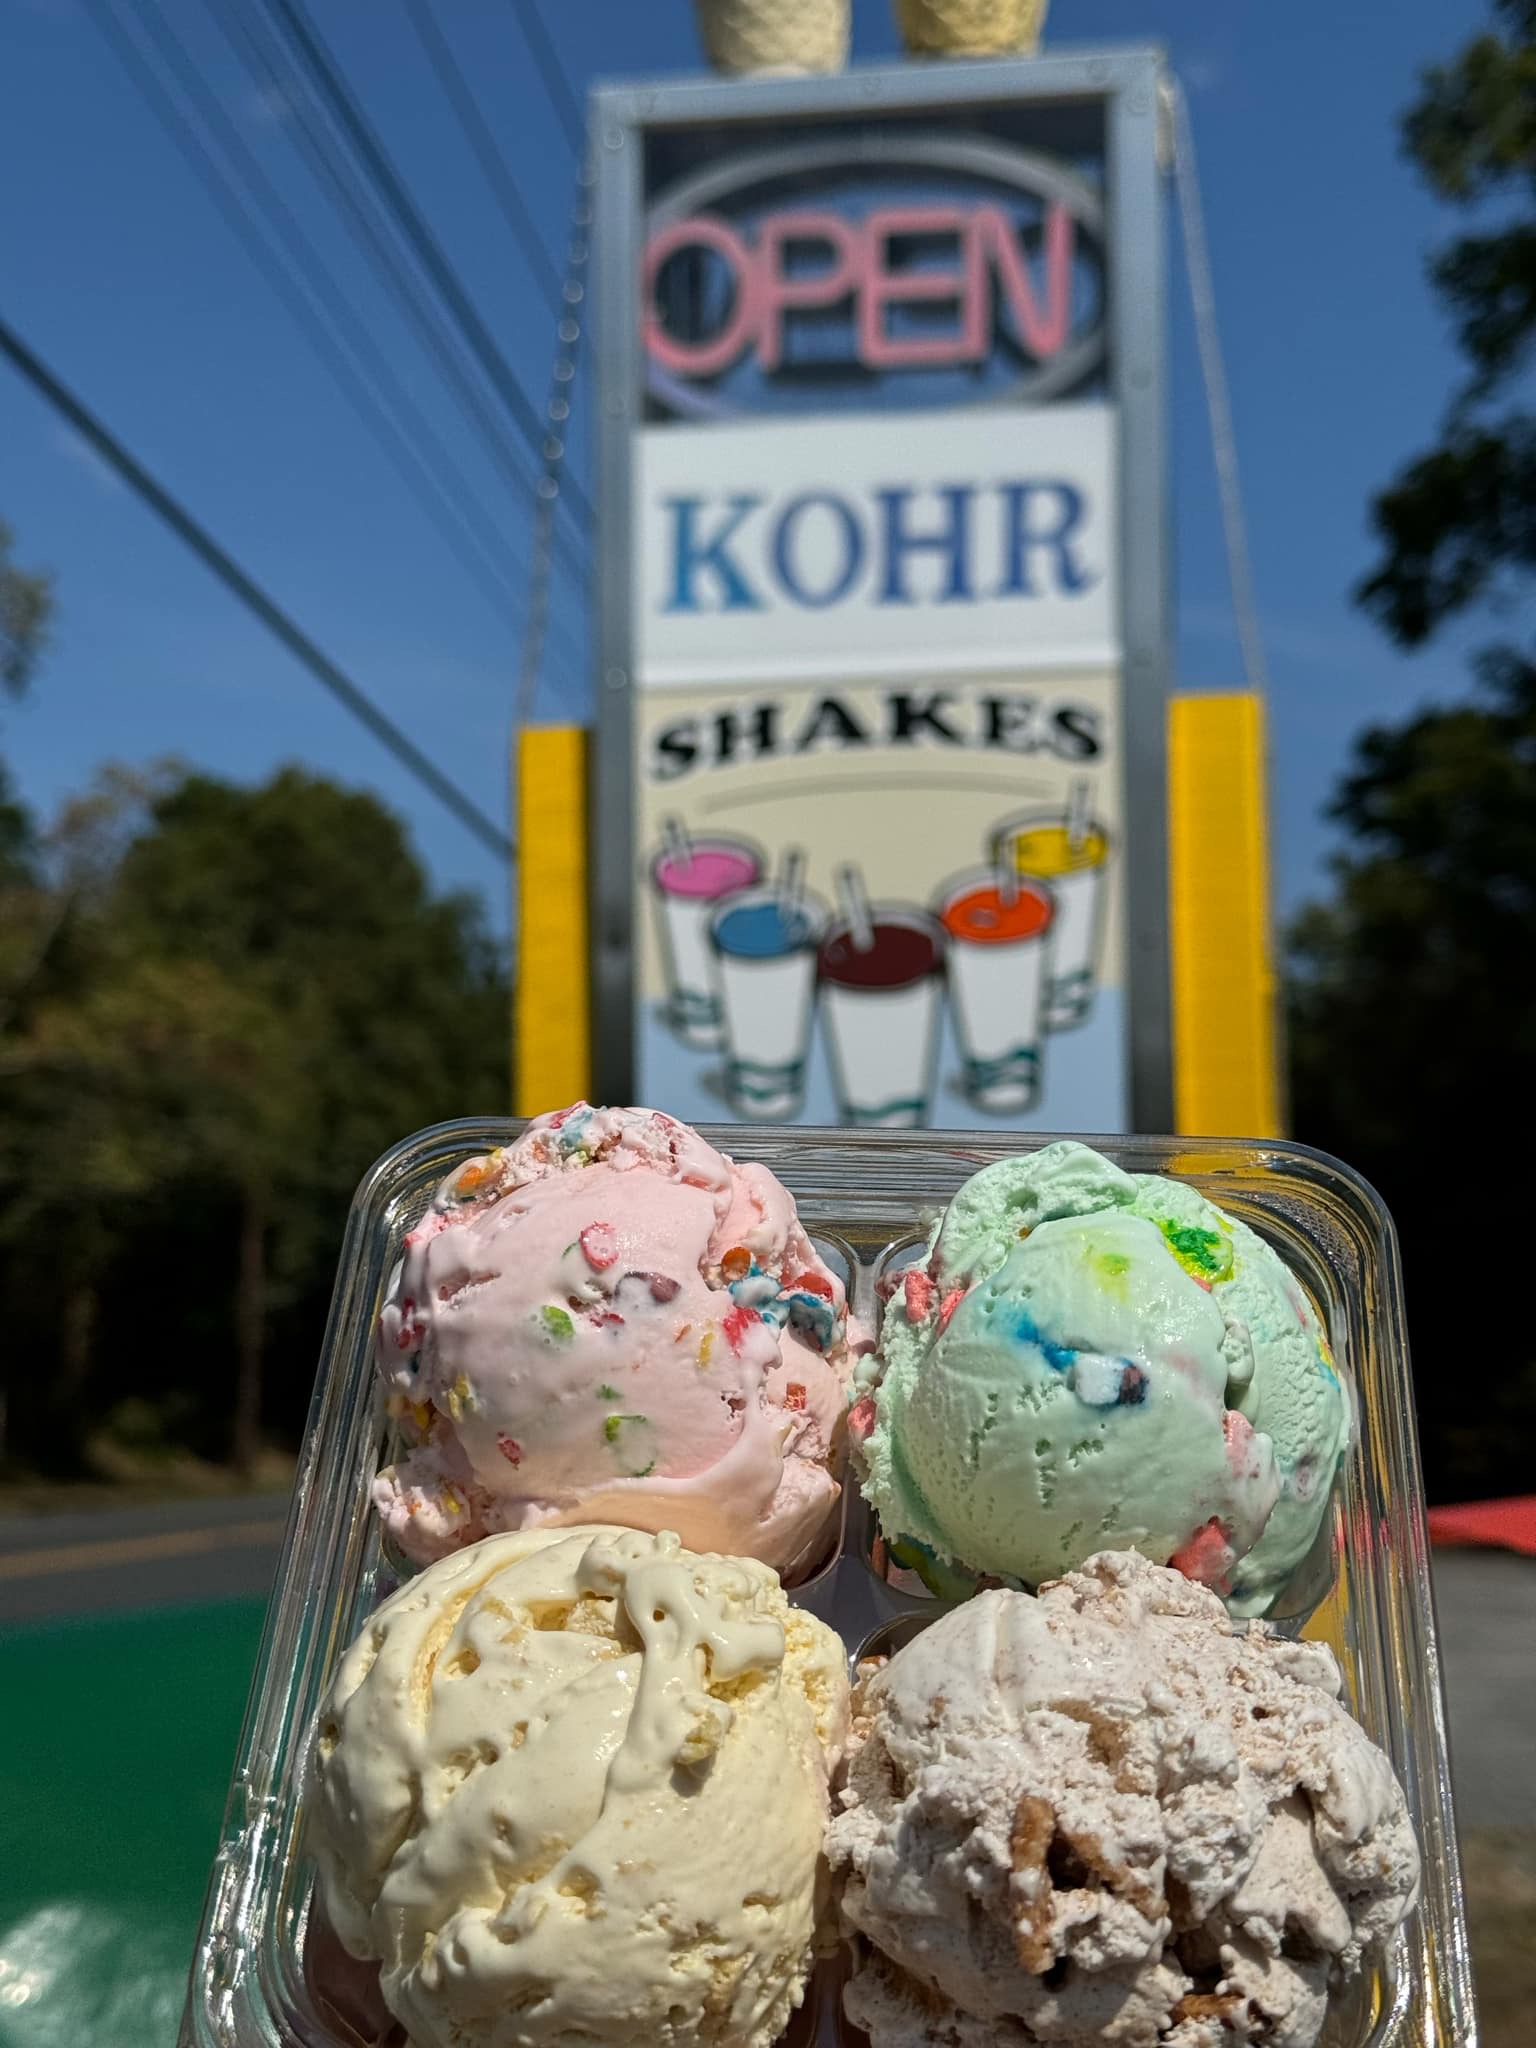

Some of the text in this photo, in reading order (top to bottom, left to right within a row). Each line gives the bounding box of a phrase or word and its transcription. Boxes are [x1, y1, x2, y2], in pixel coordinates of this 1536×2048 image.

[642, 199, 1074, 375] OPEN
[660, 479, 1098, 614] KOHR
[652, 689, 1103, 779] SHAKES
